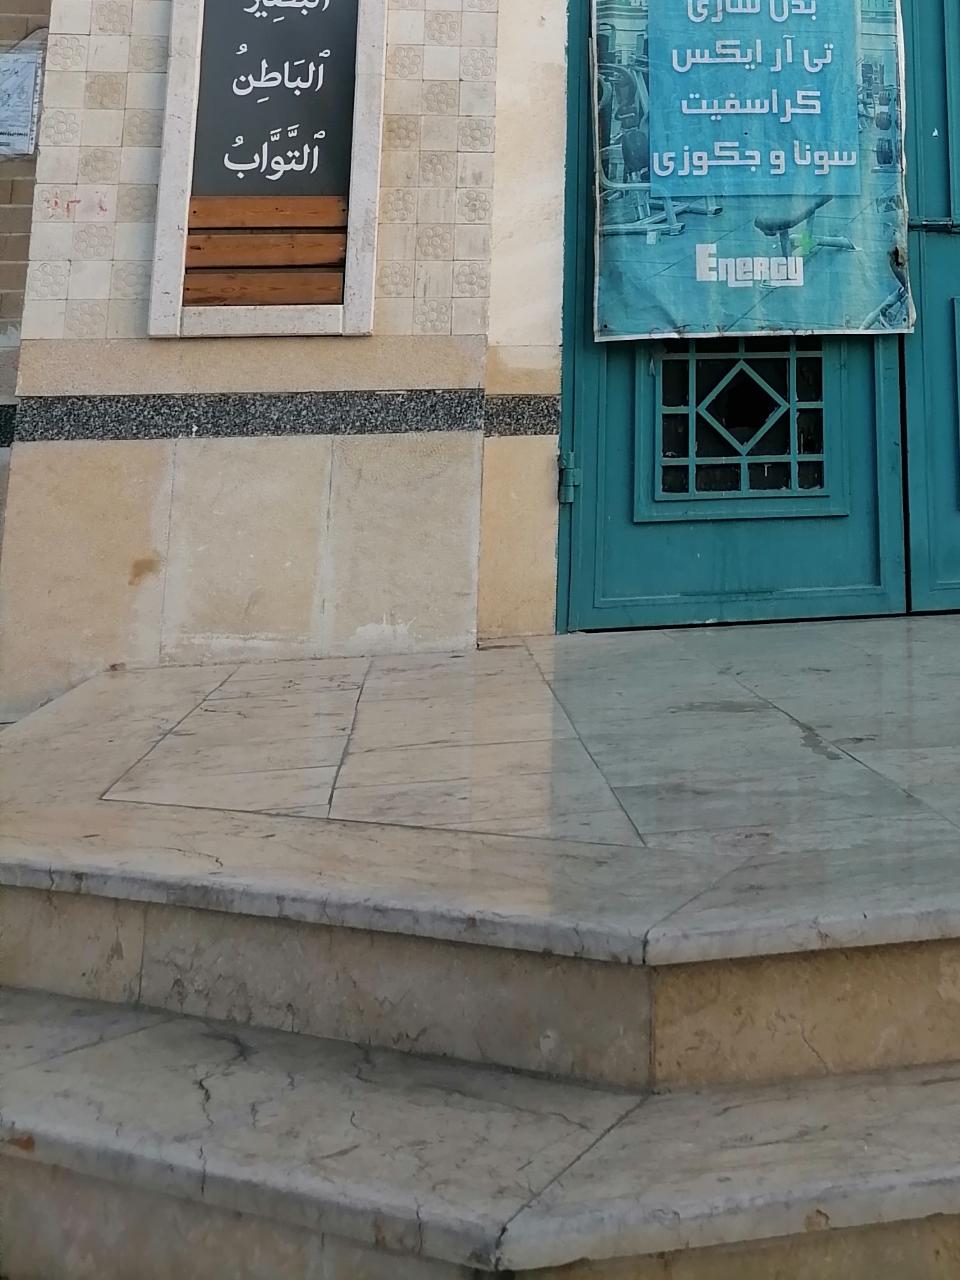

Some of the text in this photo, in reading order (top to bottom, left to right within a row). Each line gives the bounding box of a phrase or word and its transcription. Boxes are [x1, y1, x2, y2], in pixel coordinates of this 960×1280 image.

[672, 34, 834, 72] تی آر ایکس
[681, 89, 821, 123] کراسفیت
[652, 139, 857, 176] سونا و جکوزی
